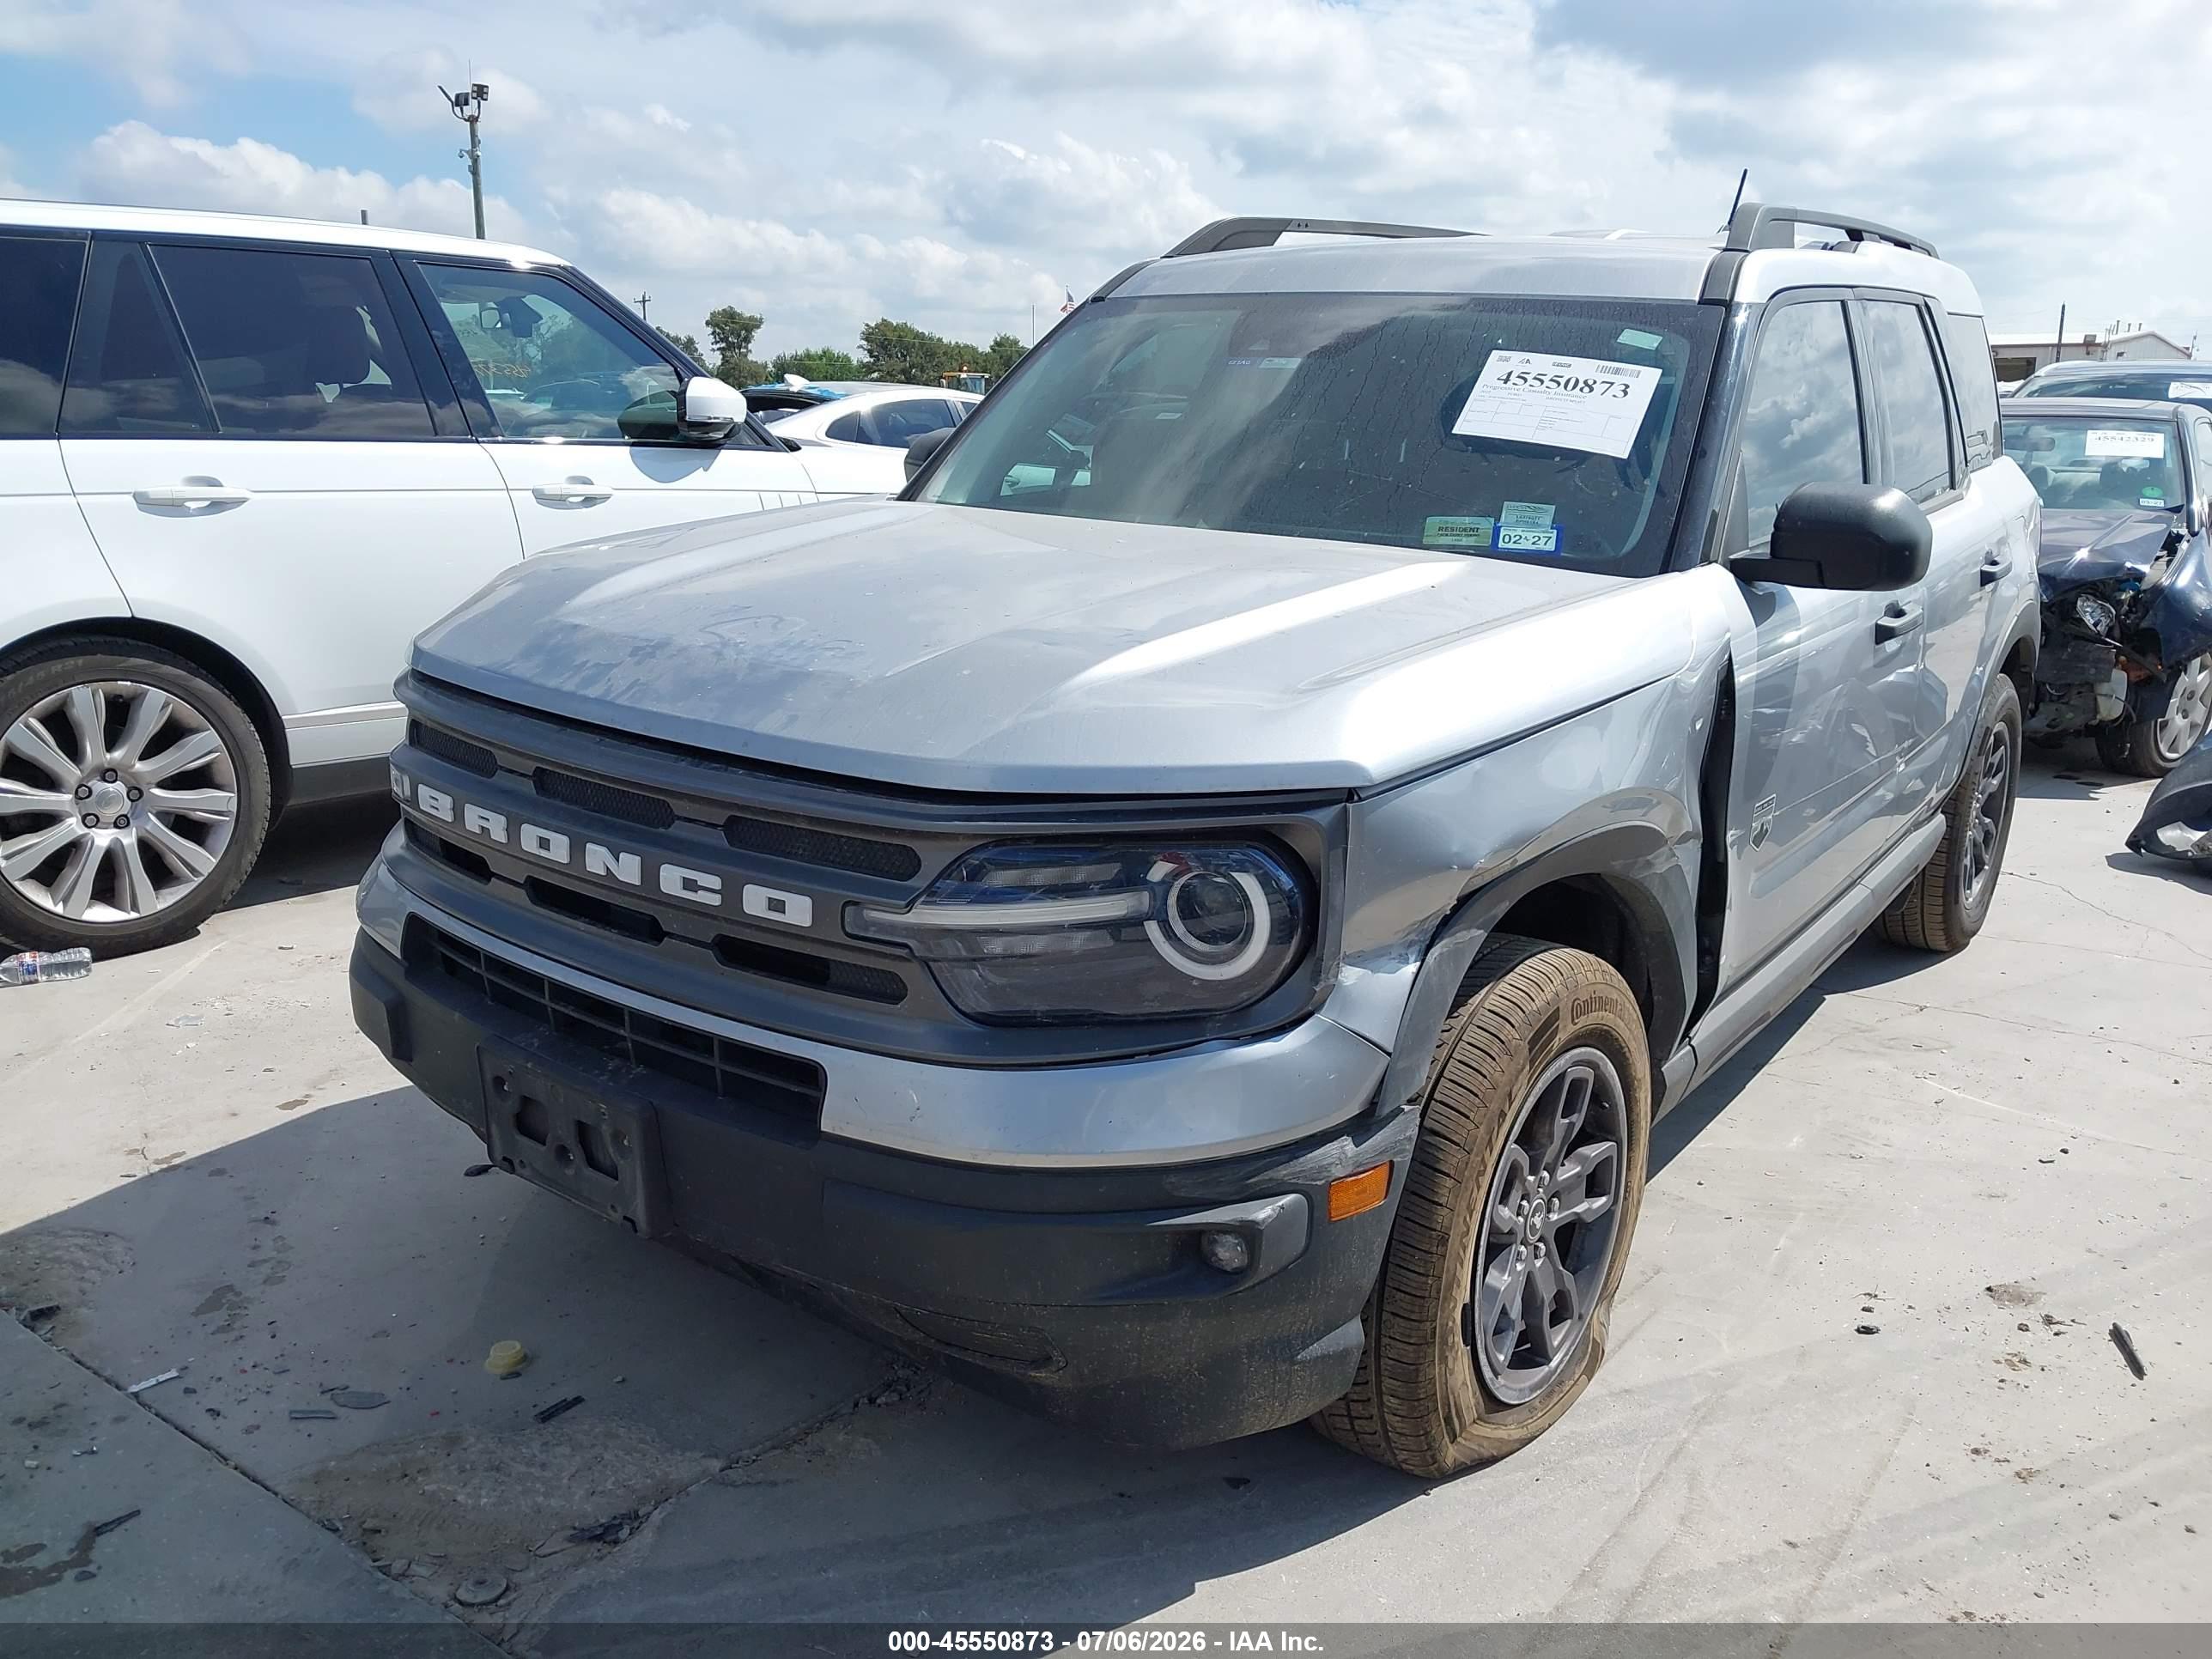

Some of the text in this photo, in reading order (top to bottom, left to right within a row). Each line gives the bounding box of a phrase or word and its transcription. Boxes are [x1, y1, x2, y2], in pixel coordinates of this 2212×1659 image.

[1482, 384, 1521, 392] Progressive
[1522, 387, 1552, 396] Casualty
[1553, 391, 1588, 399] Insurance
[1497, 370, 1631, 399] 45550873
[417, 783, 813, 927] BRONCO
[1571, 990, 1626, 1026] Continental
